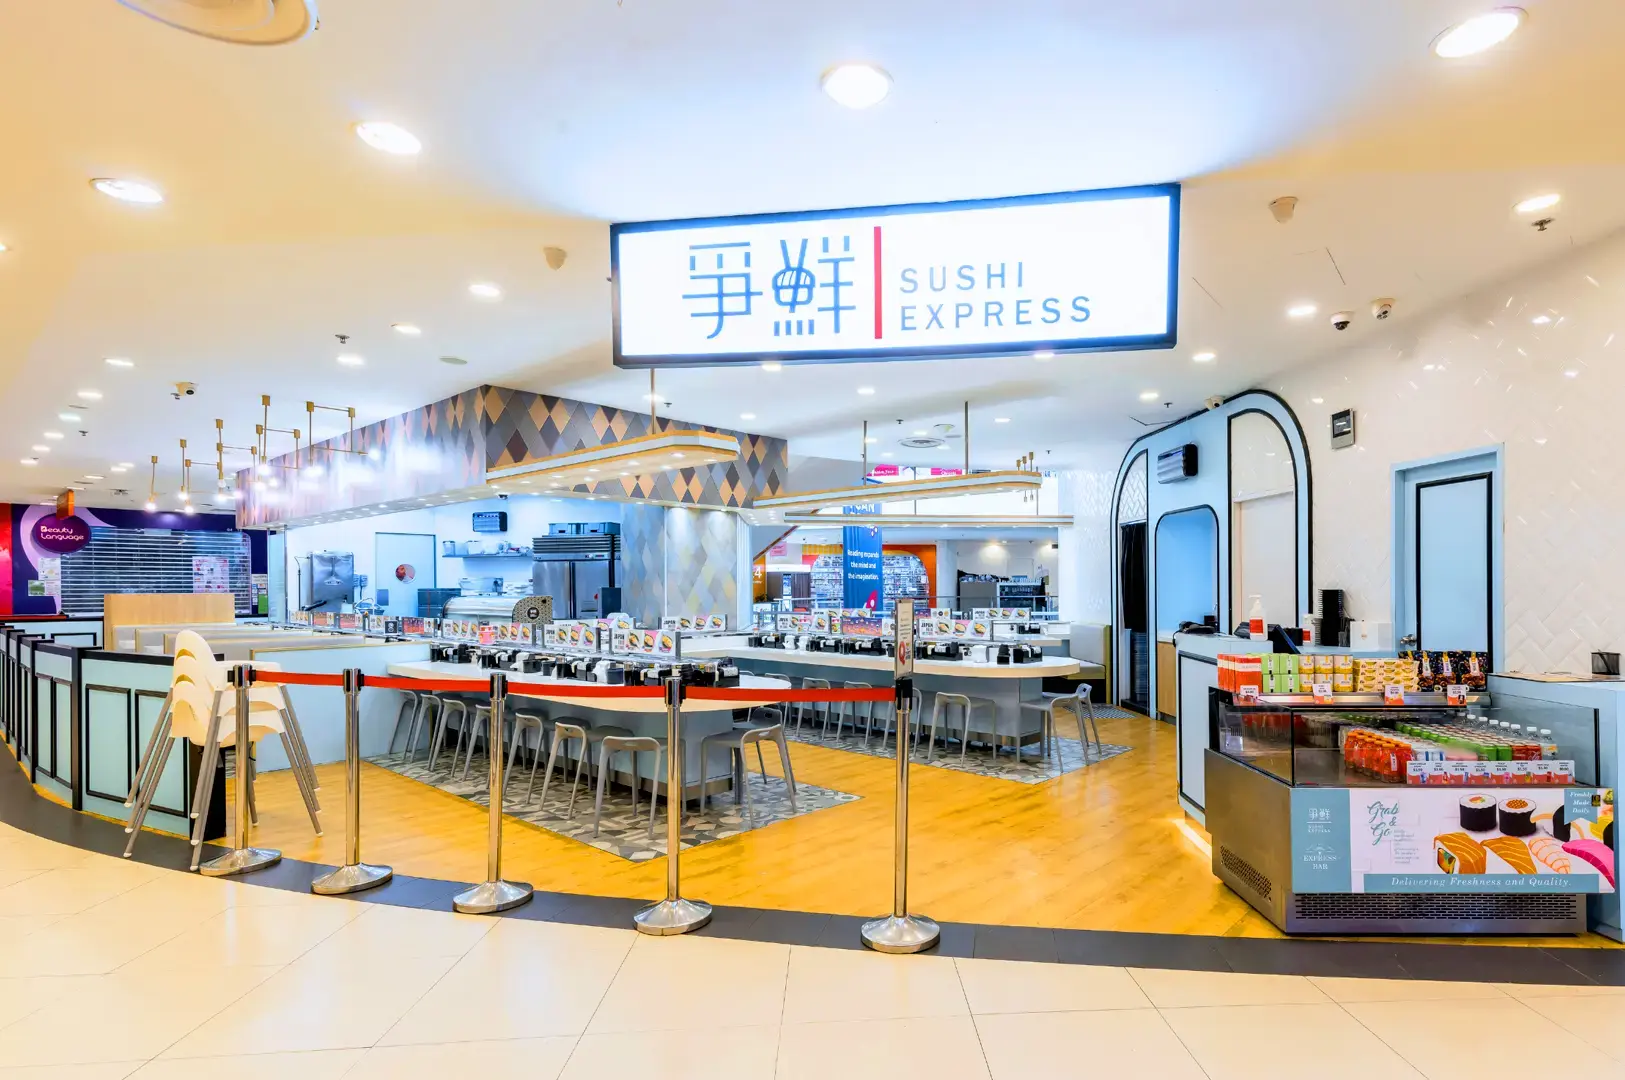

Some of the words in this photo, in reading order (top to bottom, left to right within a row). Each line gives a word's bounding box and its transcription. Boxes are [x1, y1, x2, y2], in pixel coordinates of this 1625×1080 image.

[900, 261, 1025, 294] SUSHI
[900, 295, 1092, 331] EXPRESS
[40, 525, 73, 534] Beauty
[40, 533, 85, 541] Language
[847, 549, 863, 558] Reading
[1367, 801, 1399, 824] Grab
[1389, 816, 1397, 826] &
[1370, 822, 1391, 846] Go
[1391, 877, 1446, 887] Delivering
[1450, 877, 1501, 886] Freshness
[1505, 877, 1525, 886] and
[1529, 877, 1572, 888] Quality.
